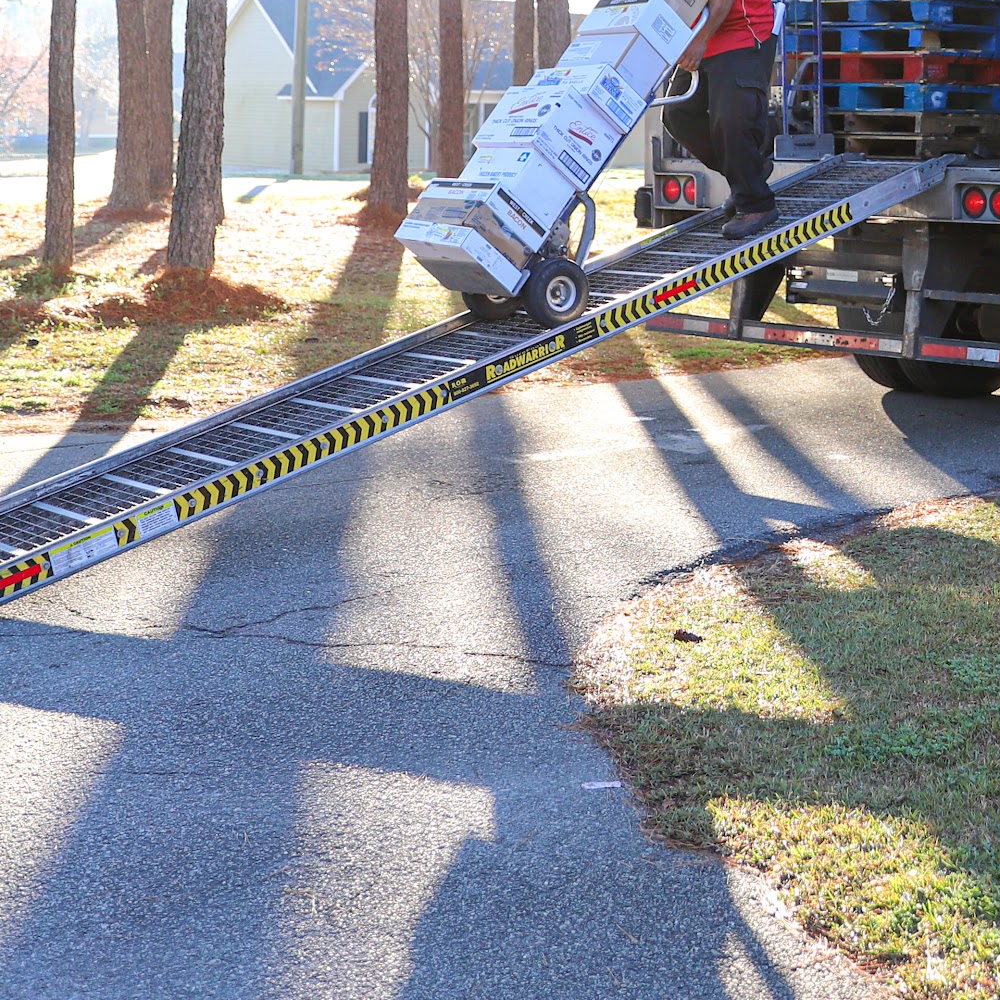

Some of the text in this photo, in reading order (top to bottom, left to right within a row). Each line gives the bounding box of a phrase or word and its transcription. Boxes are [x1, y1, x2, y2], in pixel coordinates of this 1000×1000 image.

[569, 120, 597, 141] Entice
[507, 209, 527, 230] BACON
[509, 200, 535, 225] WEST CREEK
[144, 505, 164, 516] CAUTION
[73, 535, 91, 547] CAUTION
